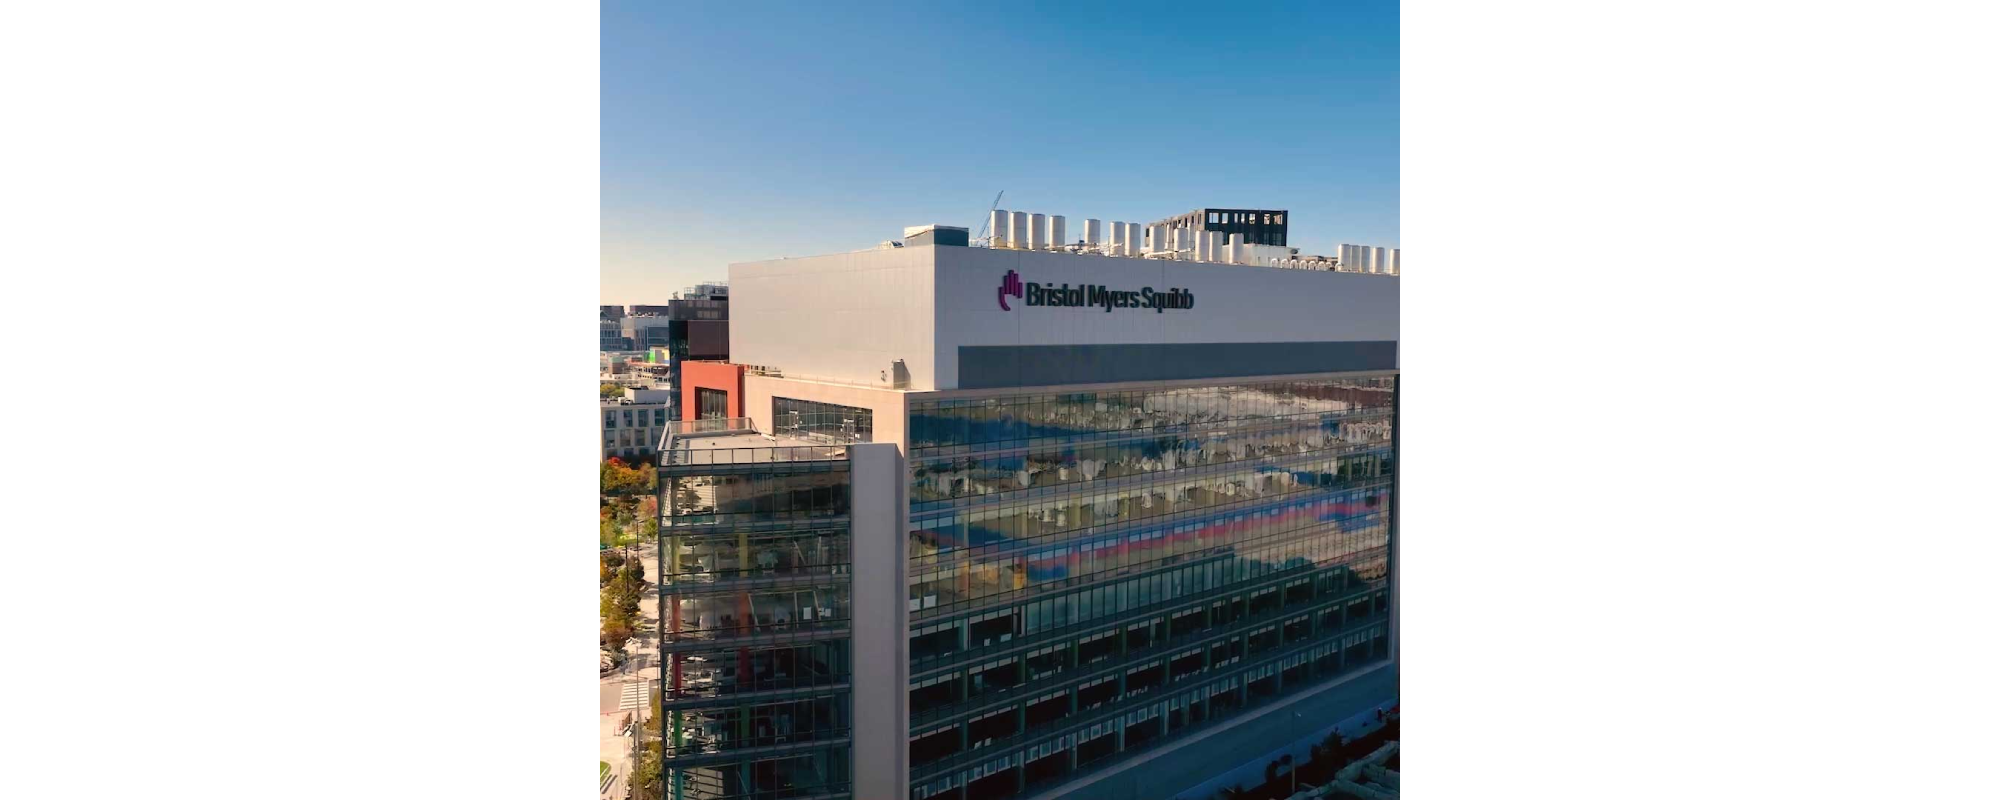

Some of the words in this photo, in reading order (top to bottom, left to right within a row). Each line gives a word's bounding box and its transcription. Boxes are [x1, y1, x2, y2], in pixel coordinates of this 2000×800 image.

[1026, 282, 1085, 307] Bristol
[1088, 284, 1140, 313] Myers
[1141, 286, 1195, 313] Squibb
